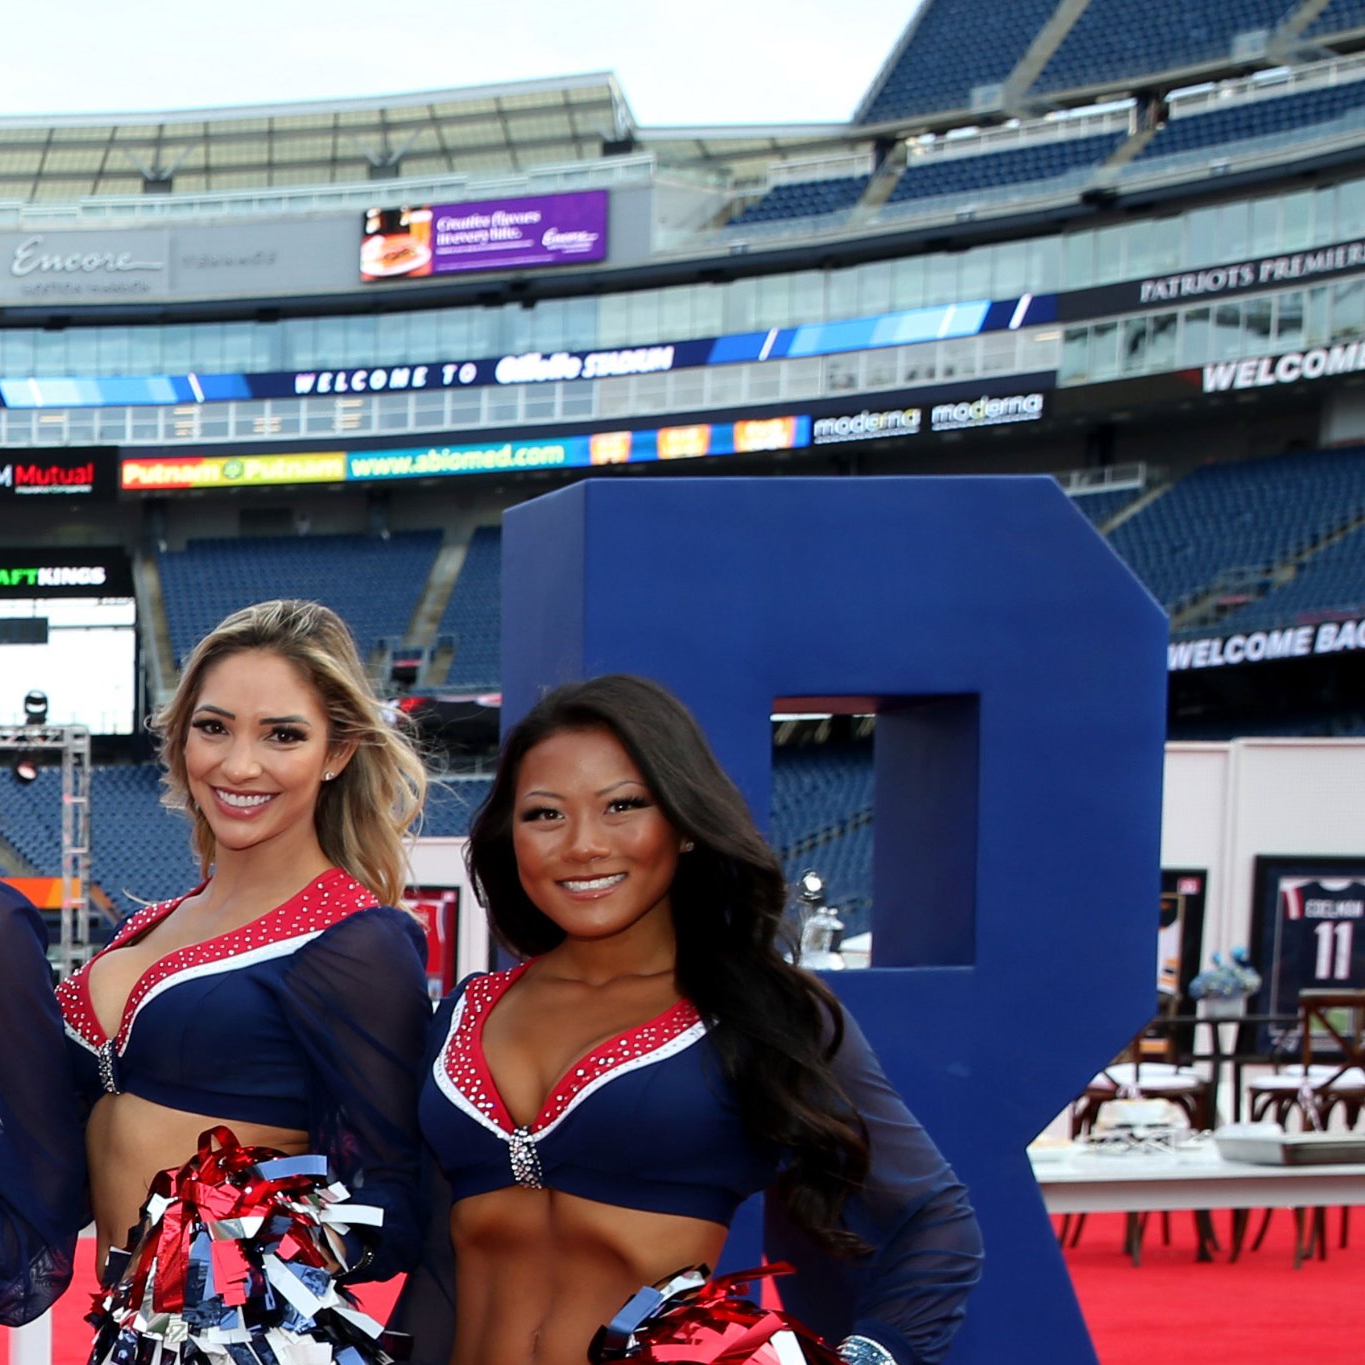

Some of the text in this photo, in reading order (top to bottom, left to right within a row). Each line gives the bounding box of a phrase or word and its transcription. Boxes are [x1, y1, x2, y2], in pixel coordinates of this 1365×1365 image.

[11, 234, 164, 277] Encore
[1139, 264, 1255, 303] PATRIOTS
[294, 365, 429, 394] WELCOME
[442, 362, 478, 385] TO
[813, 408, 921, 438] moderna
[931, 394, 1044, 426] moderna
[14, 462, 95, 485] Mutual
[123, 461, 217, 486] Putnam
[245, 456, 343, 481] Putnam
[350, 444, 565, 478] www.abiomed.com
[1167, 625, 1315, 671] WELCOME
[1304, 898, 1364, 919] EDELMAN
[1314, 920, 1354, 980] 11
